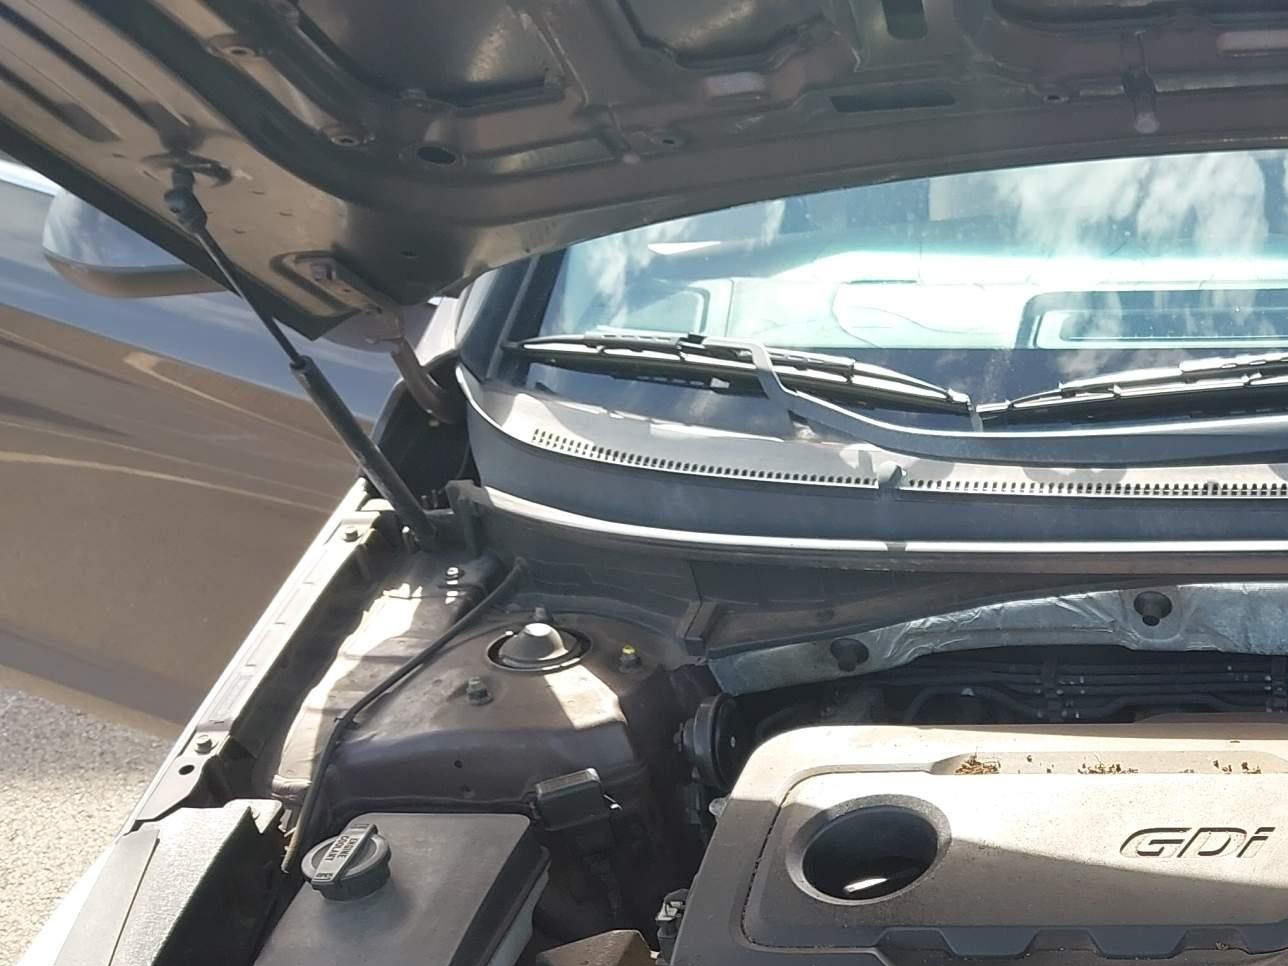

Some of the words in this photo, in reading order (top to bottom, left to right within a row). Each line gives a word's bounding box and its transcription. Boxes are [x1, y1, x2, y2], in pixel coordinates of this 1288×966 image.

[325, 836, 349, 861] COOLANT
[337, 838, 359, 859] ENGINE
[1119, 826, 1276, 858] GDi
